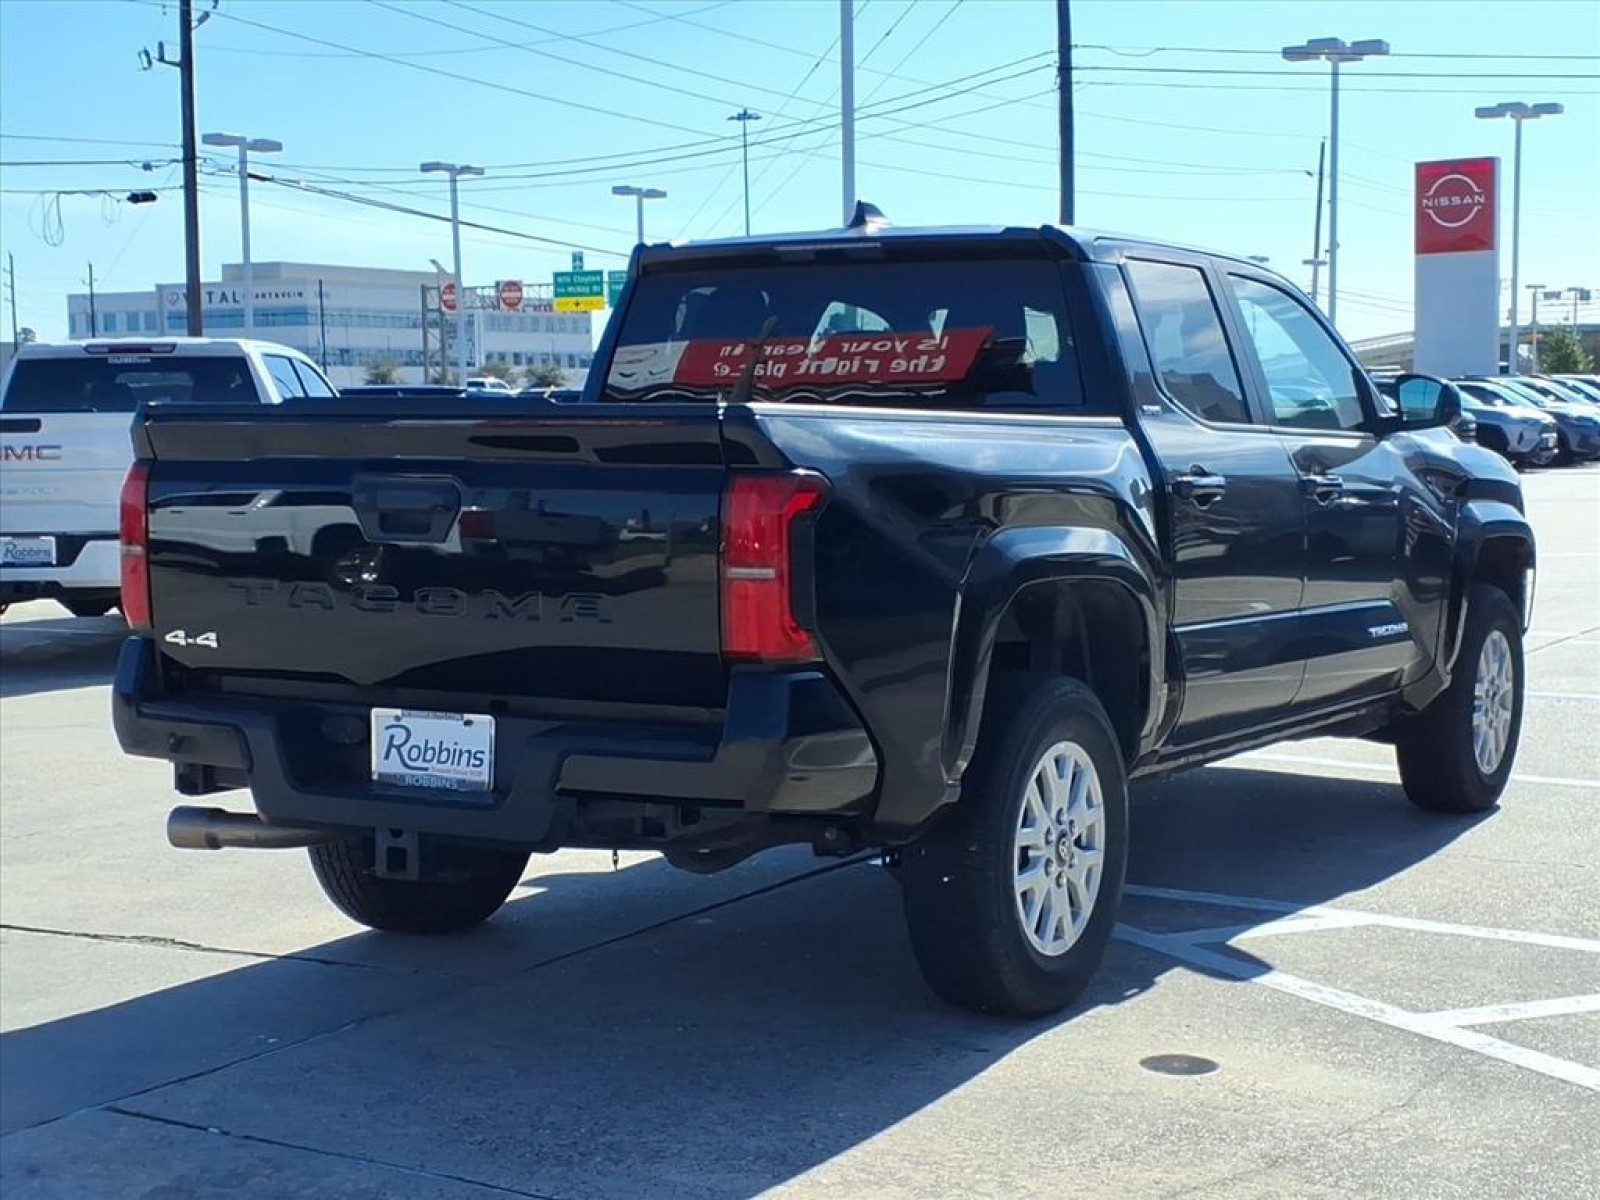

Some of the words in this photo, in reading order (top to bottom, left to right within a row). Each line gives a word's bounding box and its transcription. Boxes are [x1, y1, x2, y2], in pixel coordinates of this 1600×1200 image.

[1422, 194, 1485, 207] NISSAN
[0, 444, 62, 461] MC
[226, 578, 613, 624] TACOMA
[383, 723, 485, 771] Robbins
[404, 775, 458, 789] ROBBINS
